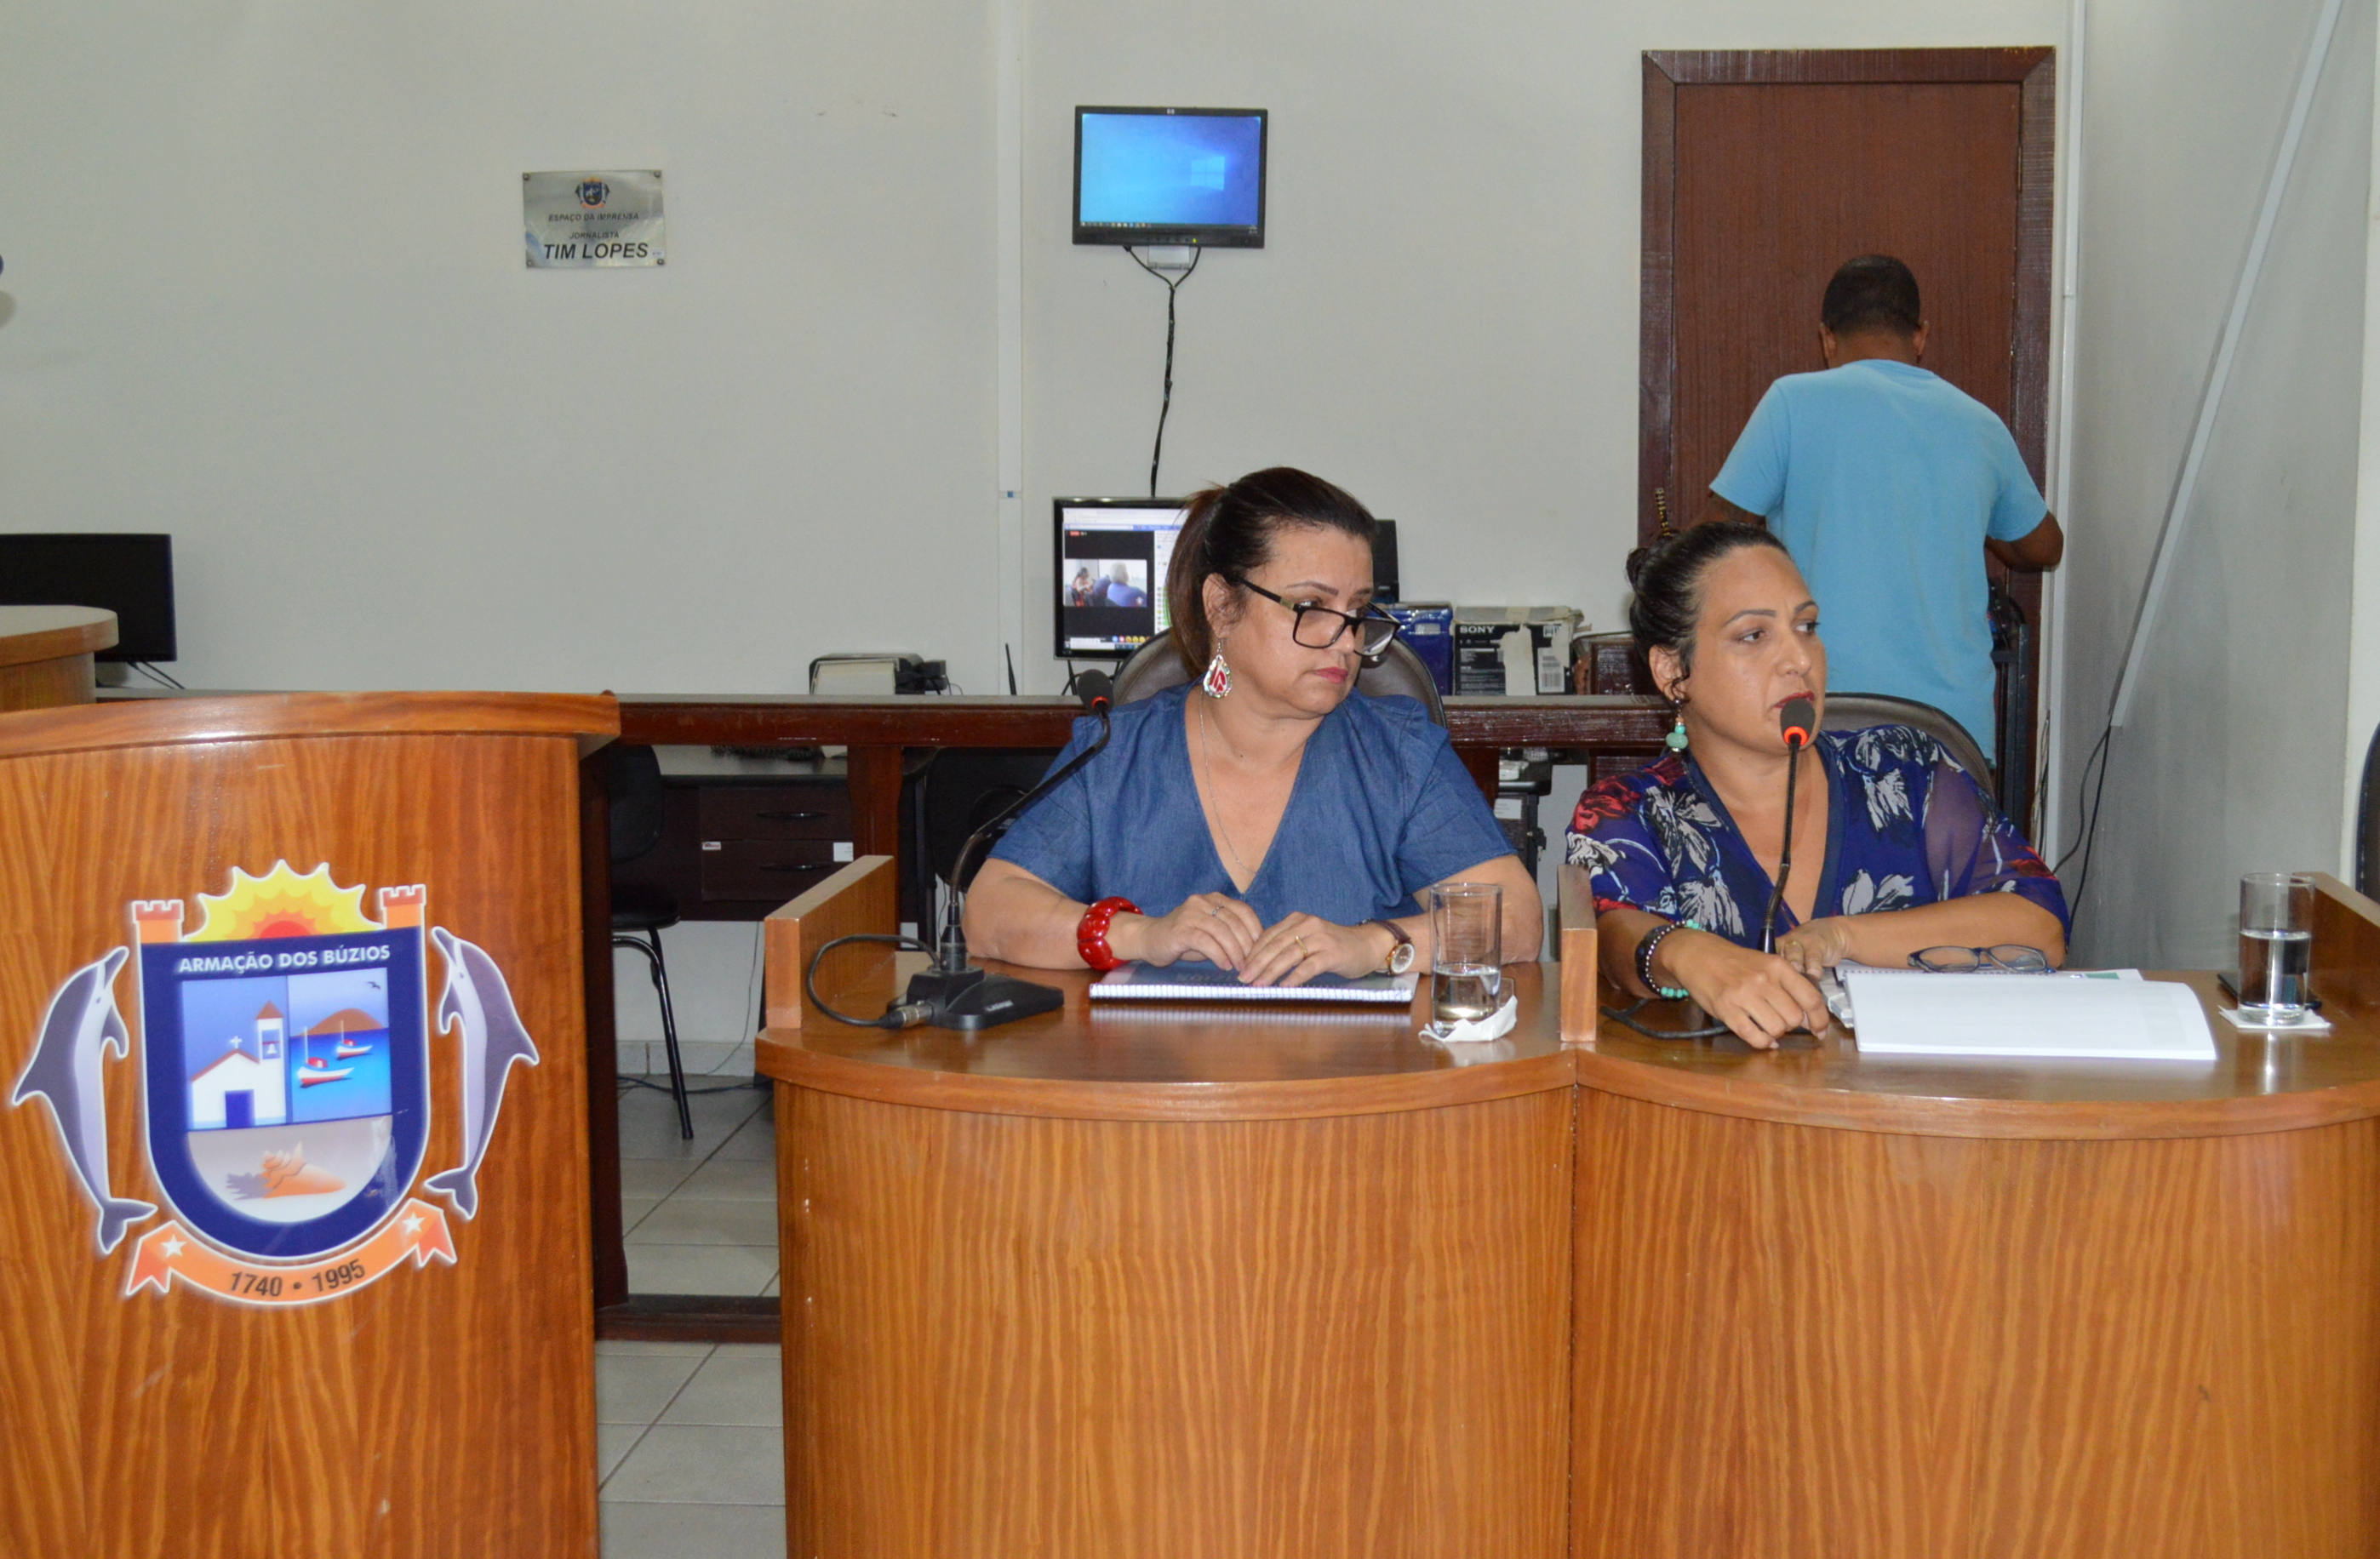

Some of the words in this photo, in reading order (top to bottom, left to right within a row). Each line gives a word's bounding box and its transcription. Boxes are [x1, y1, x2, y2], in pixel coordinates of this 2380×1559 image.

[548, 214, 581, 222] ESPAÇO
[597, 212, 639, 221] IMPRENSA
[569, 231, 620, 239] JORNALISTA
[543, 243, 576, 260] TIM
[581, 242, 649, 259] LOPES
[1460, 625, 1495, 634] SONY
[179, 951, 273, 974] ARMAÇÃO
[278, 951, 318, 968] DOS
[323, 944, 391, 965] BÚZIOS
[232, 1271, 283, 1297] 1740
[312, 1258, 366, 1293] 1995
